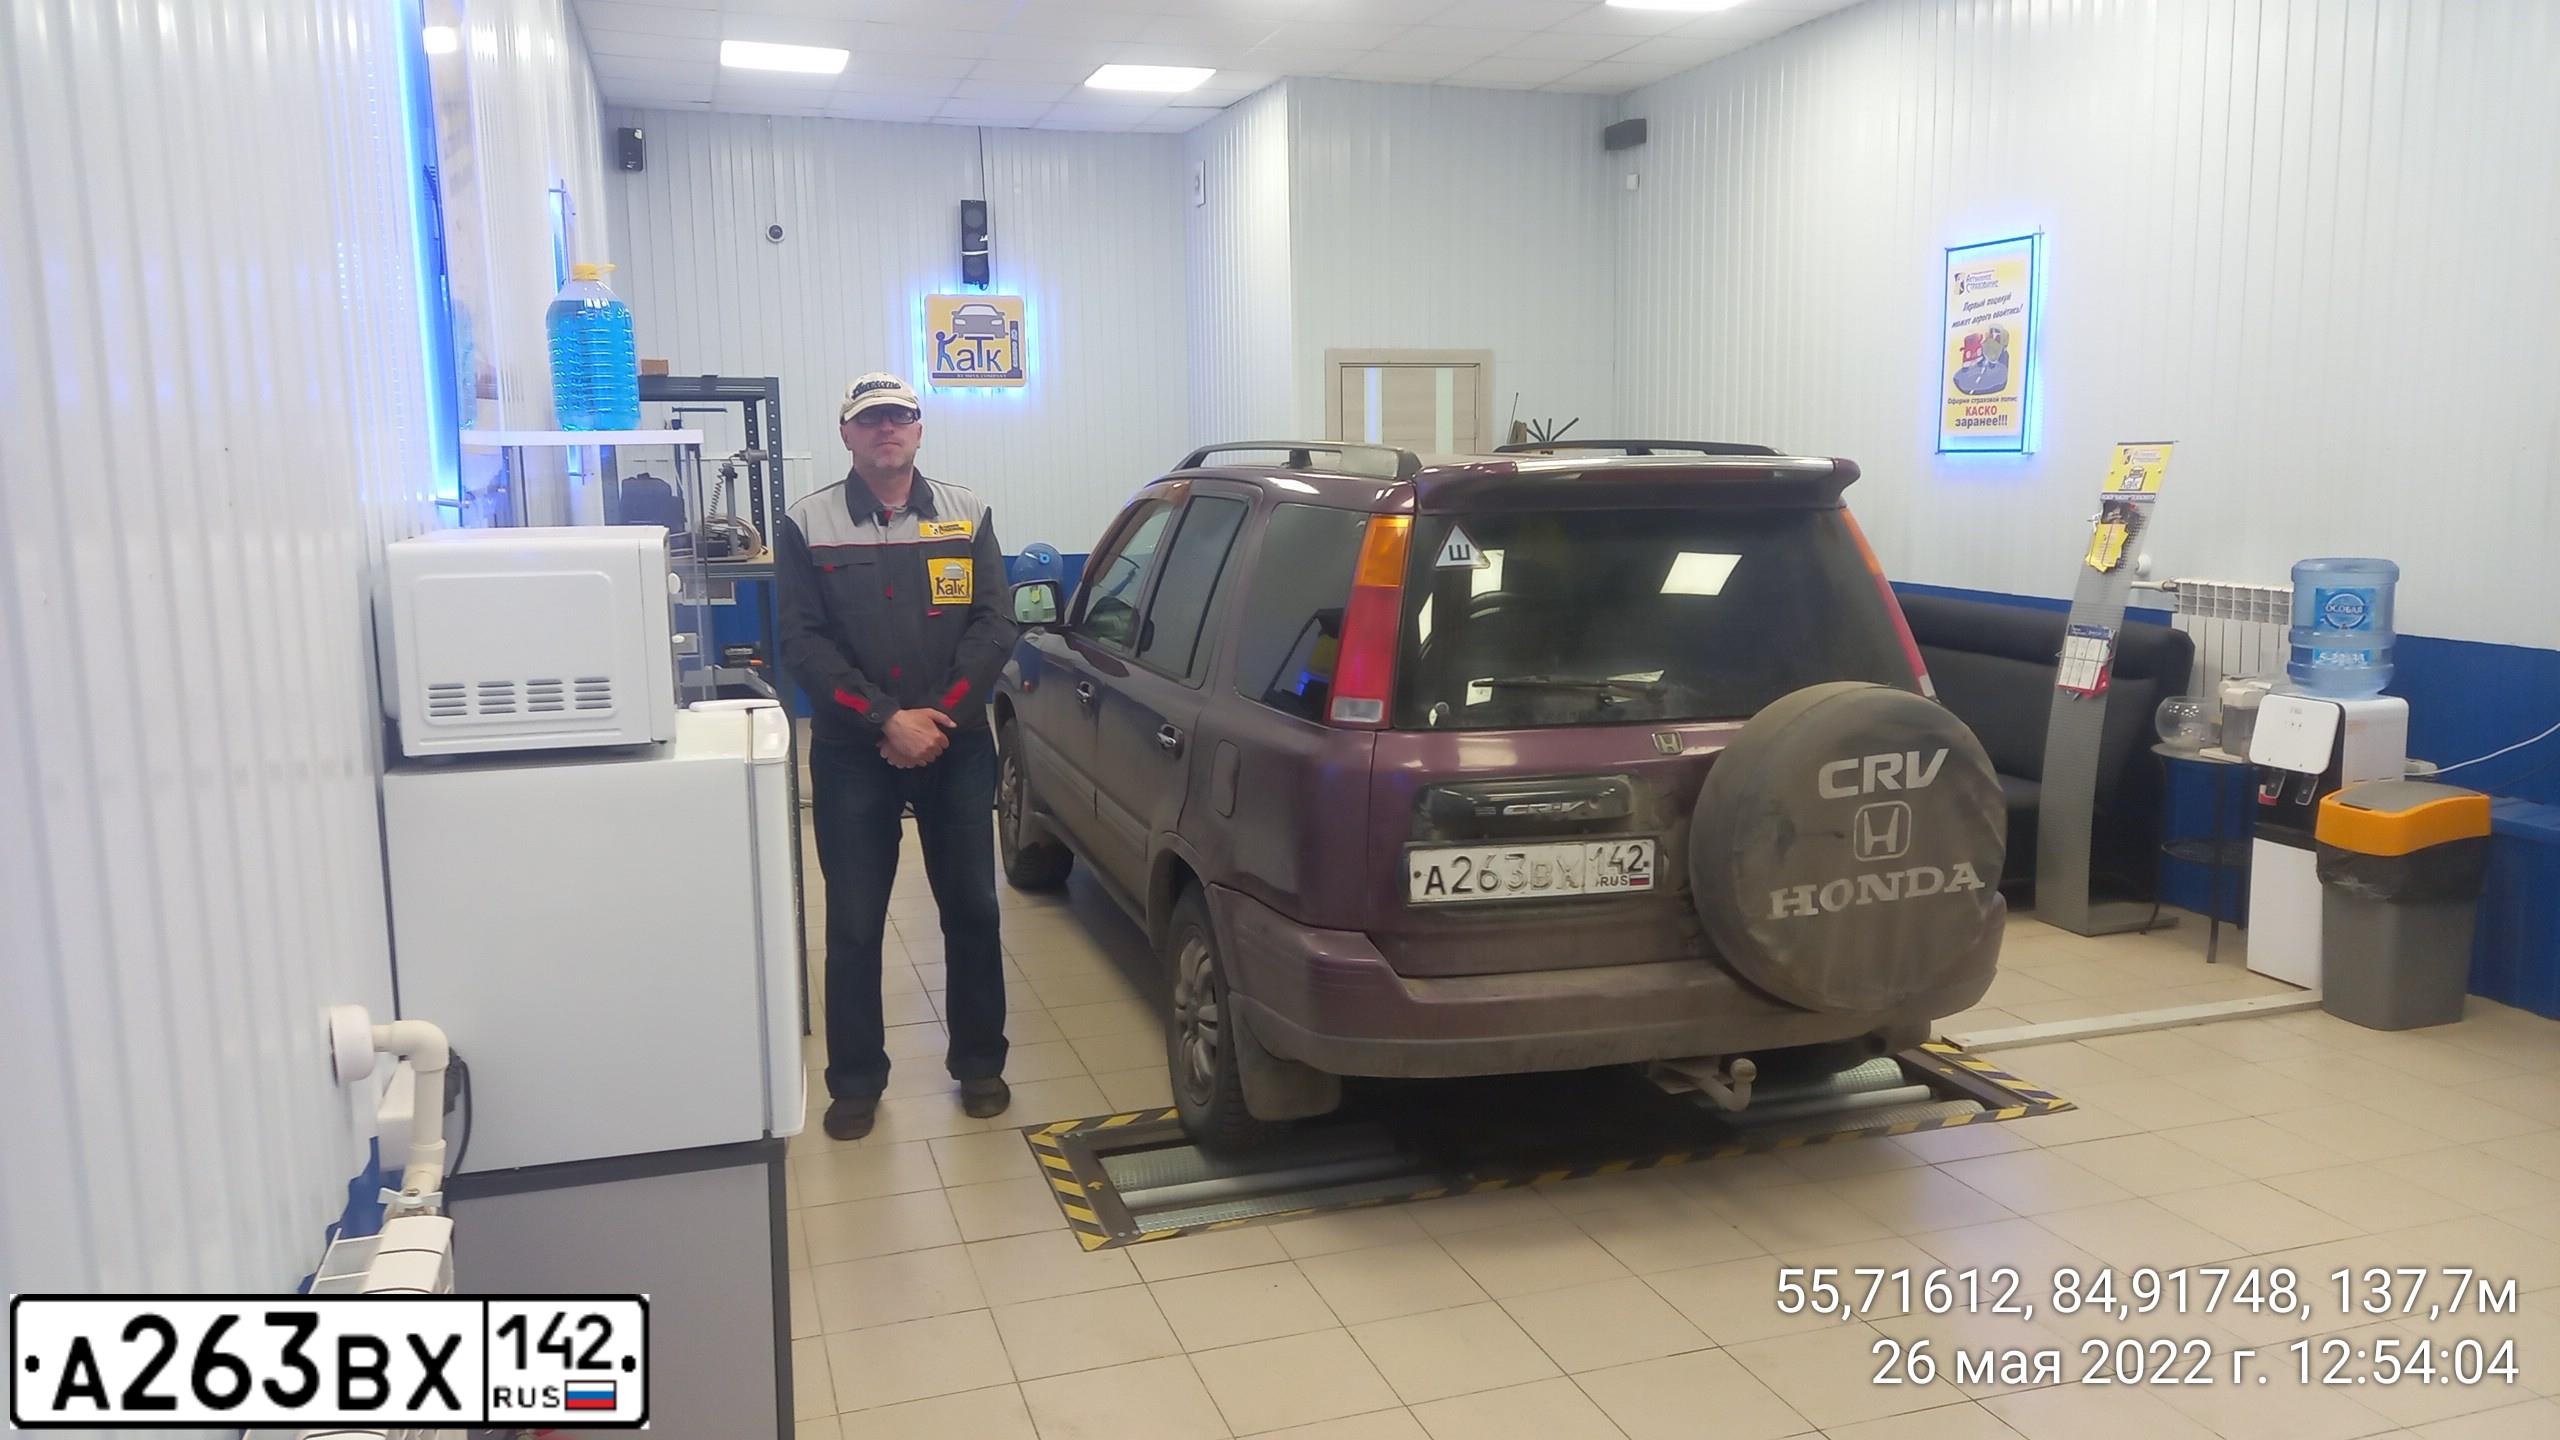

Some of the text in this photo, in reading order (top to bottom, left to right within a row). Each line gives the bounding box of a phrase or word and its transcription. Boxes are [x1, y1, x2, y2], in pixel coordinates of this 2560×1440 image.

[1965, 405, 1997, 416] КАСКО
[1955, 414, 2008, 429] заранее!!!
[1448, 543, 1471, 561] Ш
[1818, 748, 1949, 800] CRV
[1589, 844, 1645, 875] 142
[1599, 875, 1628, 887] RUS
[1767, 861, 1986, 921] HONDA
